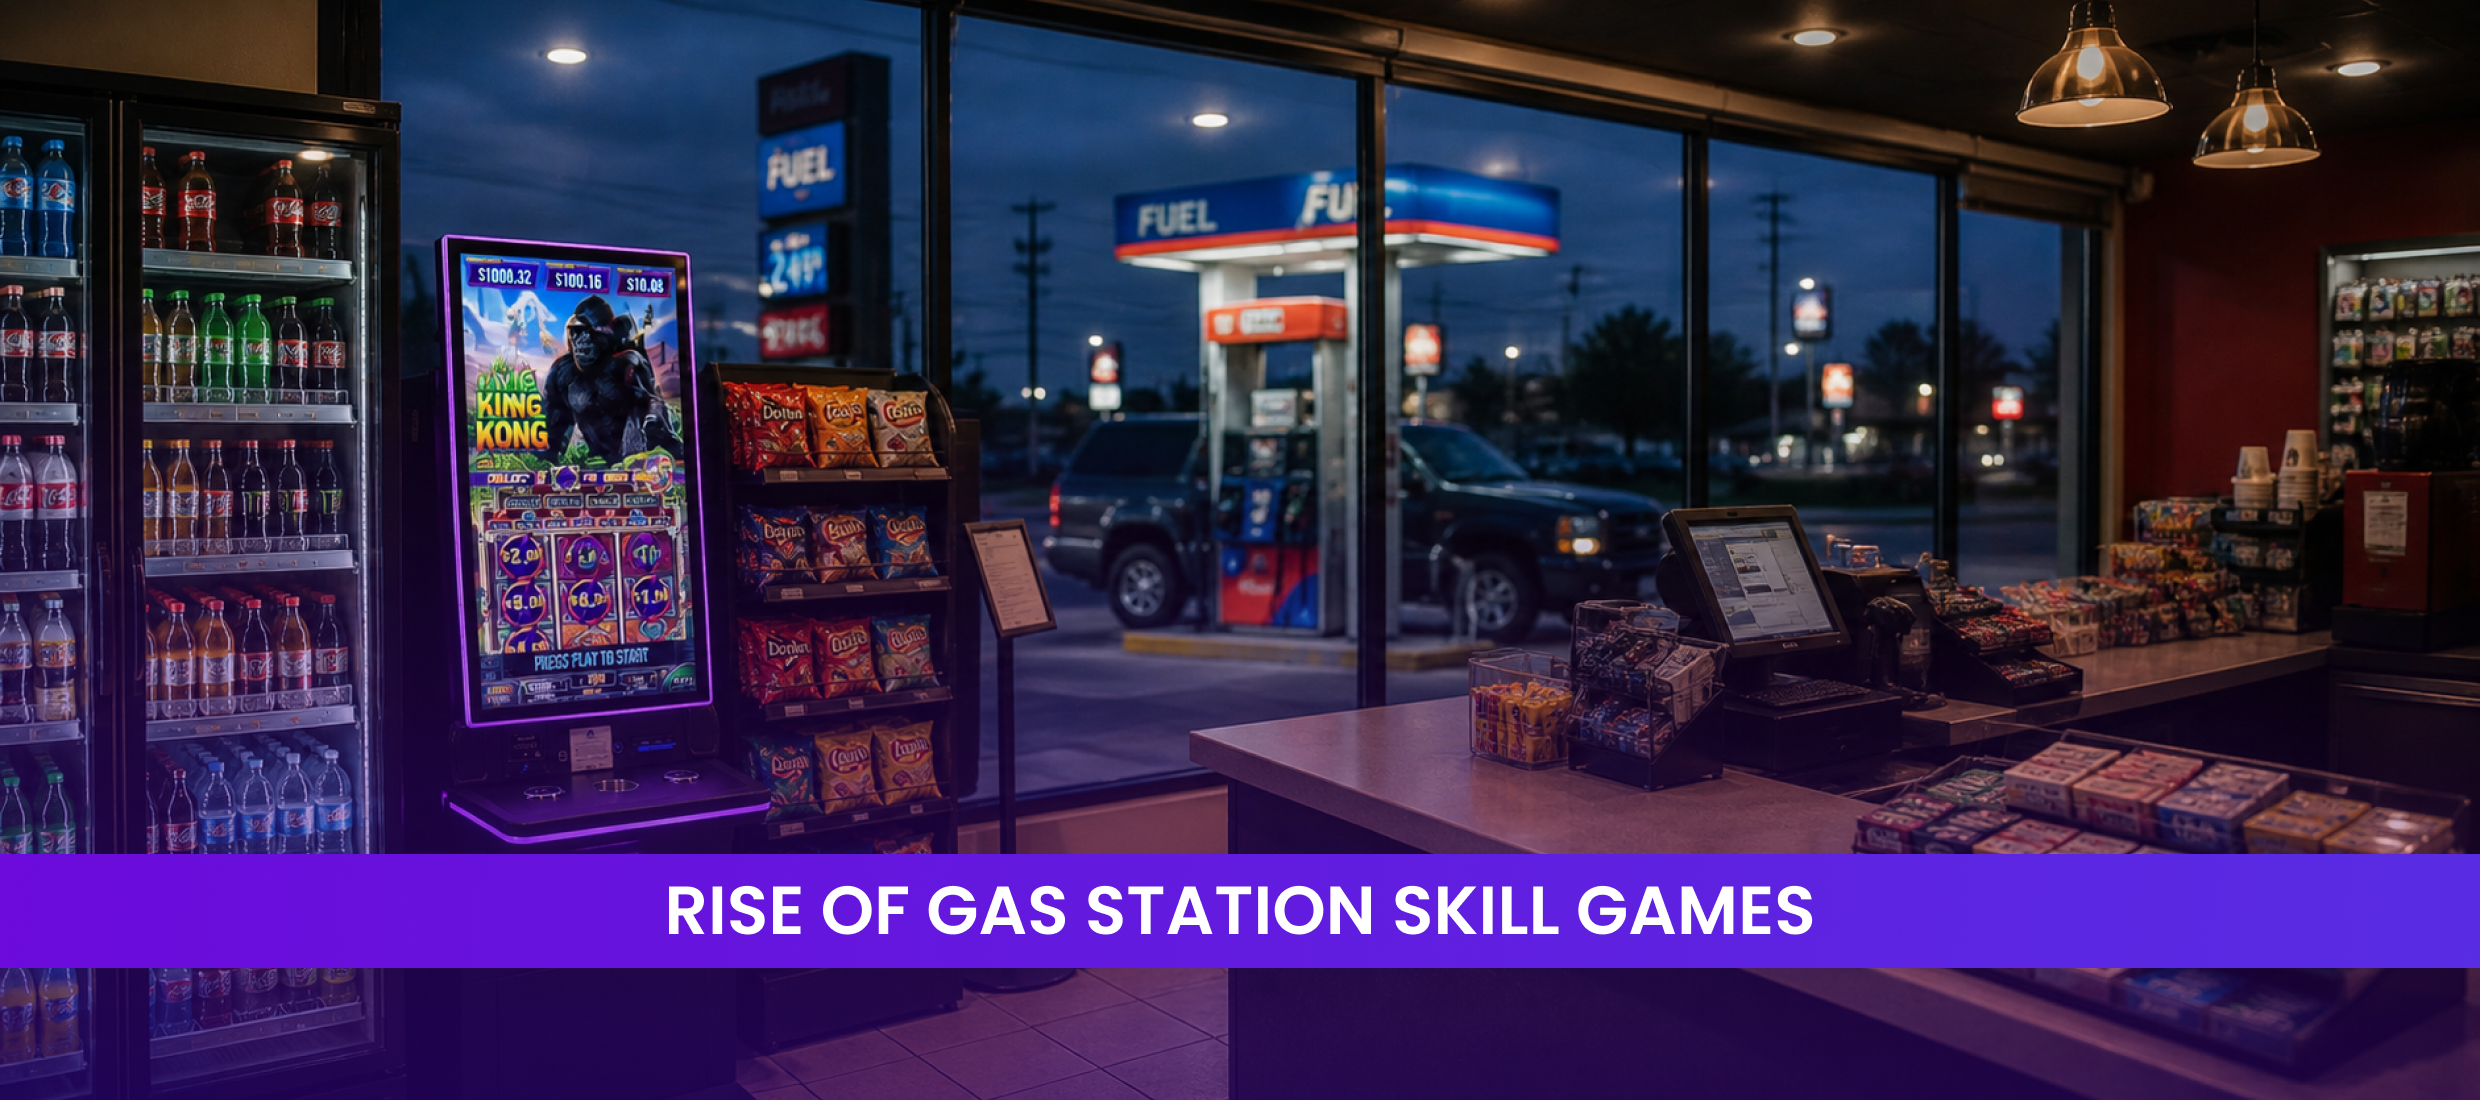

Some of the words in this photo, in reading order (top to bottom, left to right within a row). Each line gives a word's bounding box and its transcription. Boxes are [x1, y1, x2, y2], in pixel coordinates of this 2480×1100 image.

[767, 144, 835, 191] FUEL
[1138, 199, 1218, 237] FUEL
[555, 272, 602, 290] $100.16
[477, 421, 549, 451] KONG
